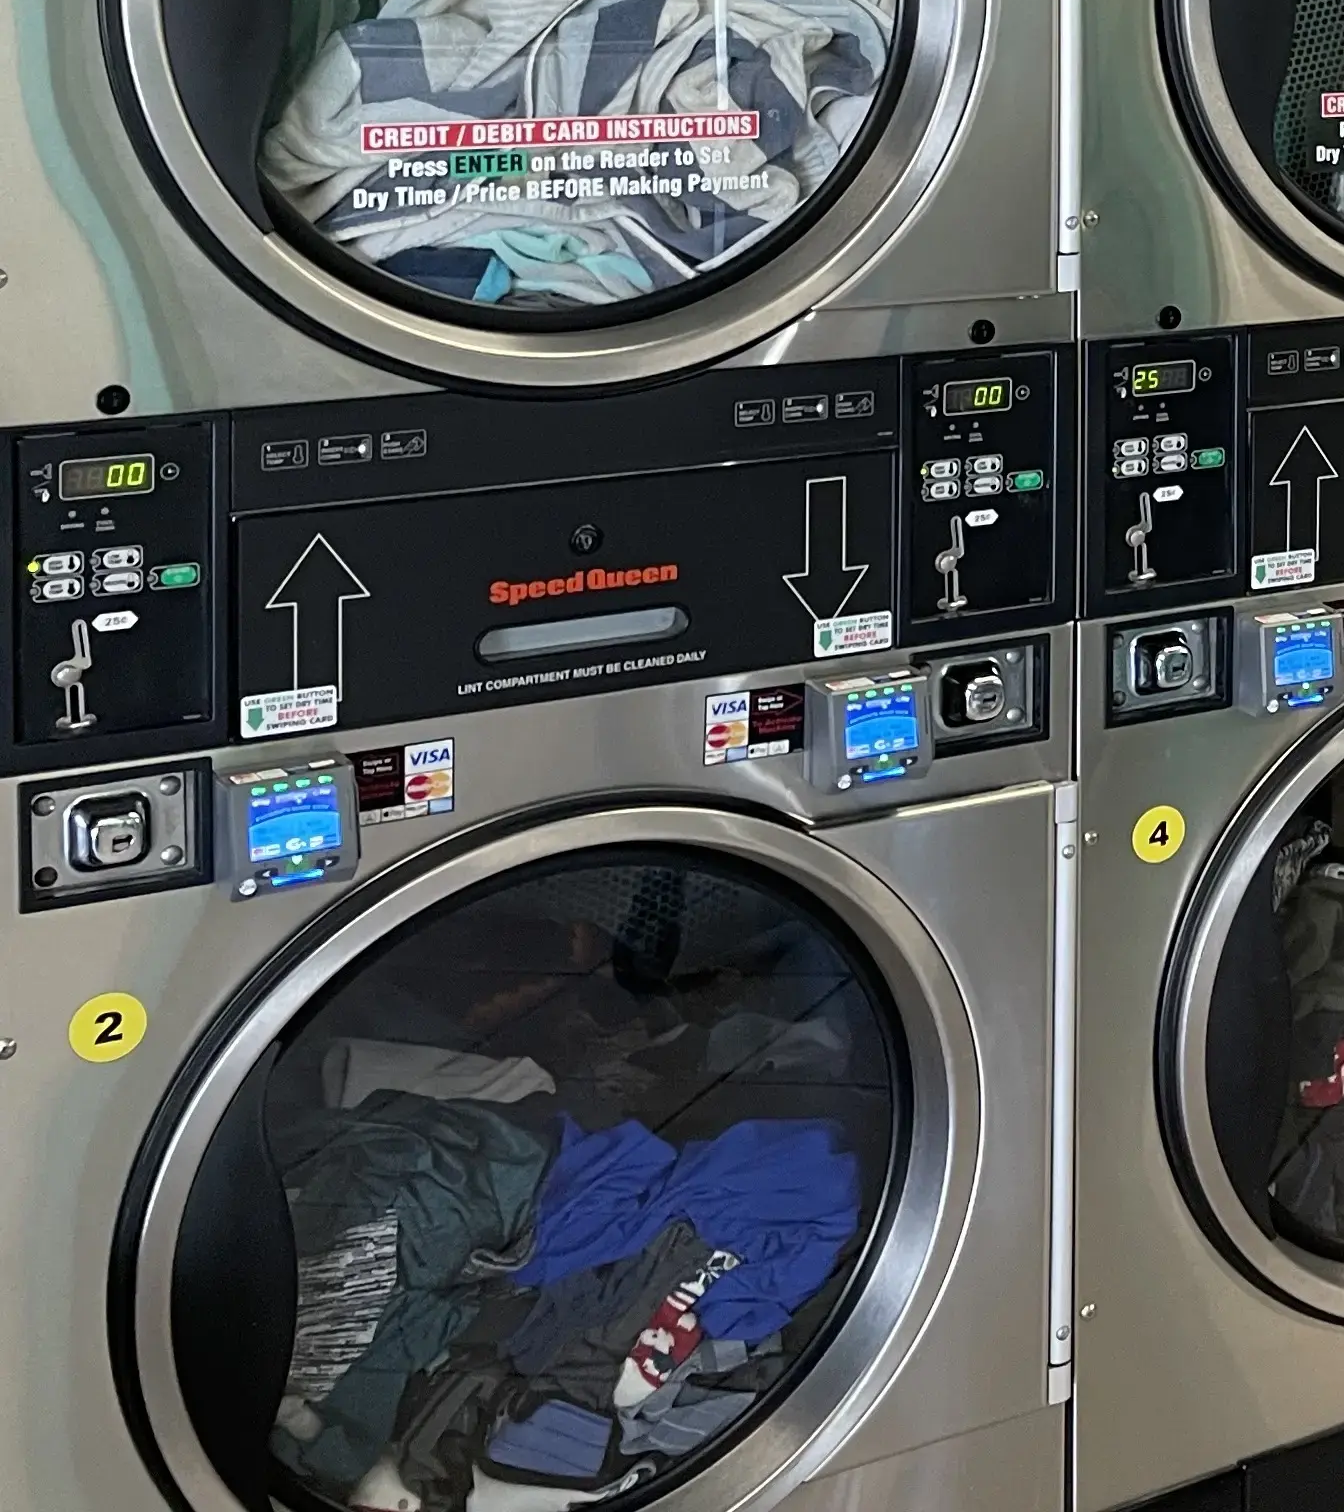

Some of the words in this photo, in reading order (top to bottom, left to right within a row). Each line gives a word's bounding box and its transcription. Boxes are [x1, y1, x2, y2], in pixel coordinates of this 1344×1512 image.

[368, 124, 449, 147] CREDIT
[456, 125, 467, 147] /
[472, 122, 536, 144] DEBIT
[542, 120, 600, 141] CARD
[606, 115, 752, 140] INSTRUCTIONS
[388, 156, 448, 178] Press
[455, 153, 523, 174] ENTER
[530, 155, 556, 172] on
[562, 149, 594, 171] the
[599, 147, 668, 169] Reader
[673, 147, 694, 167] to
[699, 145, 730, 165] Set
[1316, 146, 1339, 164] Dry
[353, 187, 388, 211] Dry
[395, 184, 446, 206] Time
[451, 184, 461, 205] /
[466, 181, 521, 203] Price
[526, 179, 604, 201] BEFORE
[609, 176, 682, 200] Making
[687, 172, 769, 194] Payment
[1134, 369, 1159, 390] 25
[973, 385, 1003, 408] 00
[106, 462, 145, 487] 00
[458, 682, 482, 695] LINT
[485, 669, 570, 692] COMPARTMENT
[573, 664, 603, 679] MUST
[605, 661, 621, 674] BE
[623, 654, 675, 672] CLEANED
[676, 650, 706, 664] DAILY
[244, 698, 261, 706] USE
[264, 694, 294, 703] GREEN
[297, 689, 333, 699] BUTTON
[314, 697, 333, 705] TIME
[712, 699, 747, 716] VISA
[266, 719, 306, 730] SWIPING
[309, 715, 333, 724] CARD
[278, 708, 318, 720] BEFORE
[410, 747, 450, 766] VISA
[1148, 821, 1169, 847] 4
[94, 1011, 123, 1045] 2
